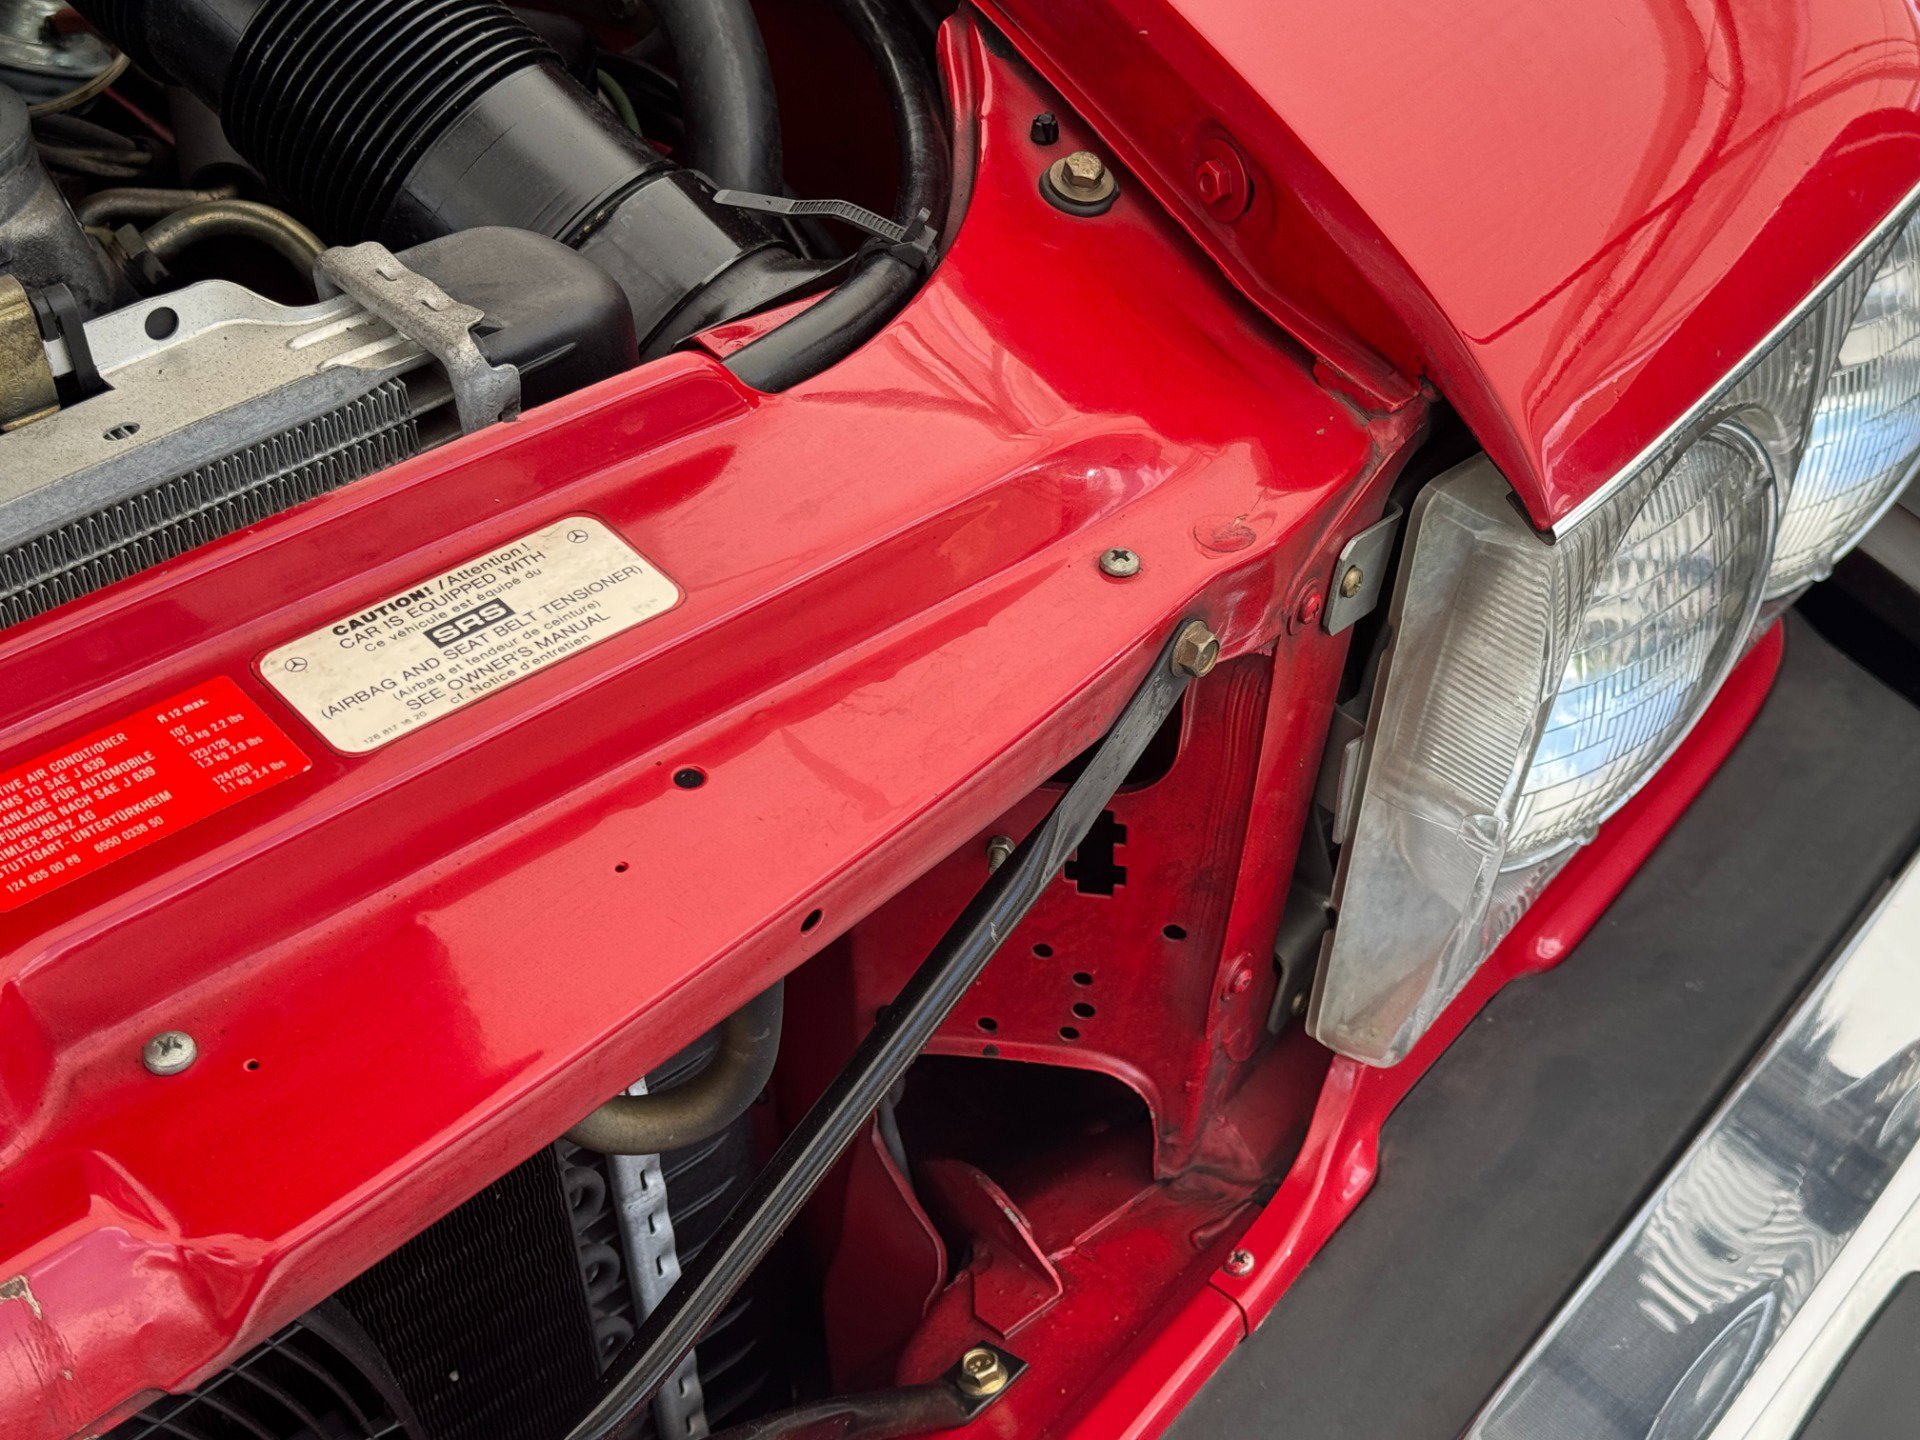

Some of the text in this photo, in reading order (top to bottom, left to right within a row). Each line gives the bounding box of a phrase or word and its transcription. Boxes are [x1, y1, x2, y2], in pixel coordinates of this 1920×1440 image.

[332, 586, 434, 636] CAUTION!
[339, 550, 546, 649] CAR IS EQUIPPED WITH
[364, 568, 542, 652] Ce véhicule est équipé du
[321, 564, 643, 720] (AIRBAG AND SEAT BELT TENSIONER)
[432, 603, 507, 643] SRS
[392, 600, 601, 701] (Airbag et tendeur de ceinture)
[405, 612, 611, 711] SEE OWNER'S MANUAL
[450, 634, 592, 704] cf. Notice d'entretien
[156, 699, 209, 724] R 12 max.
[169, 724, 188, 739] 107
[194, 728, 211, 740] kg
[209, 719, 228, 733] 2.2
[226, 713, 245, 725] lbs
[363, 733, 381, 744] 126
[413, 710, 427, 721] 20
[26, 768, 48, 784] AIR
[49, 732, 128, 774] CONDITIONER
[189, 737, 231, 761] 123/126
[213, 751, 230, 762] kg
[229, 741, 247, 755] 2.9
[245, 735, 264, 747] lbs
[24, 785, 43, 799] TO
[44, 773, 71, 791] SAE
[74, 768, 82, 778] J
[82, 756, 107, 773] 639
[51, 785, 78, 803] FÜR
[79, 750, 156, 791] AUTOMOBILE
[211, 761, 253, 786] 124/201
[235, 775, 253, 787] kg
[252, 765, 270, 779] 2.4
[268, 759, 287, 771] lbs
[0, 765, 156, 846] FÜHRUNG NACH SAE J 639
[78, 809, 97, 825] AG
[6, 879, 27, 894] 124
[27, 868, 50, 885] 835
[49, 860, 66, 874] 00
[148, 815, 164, 828] 50
